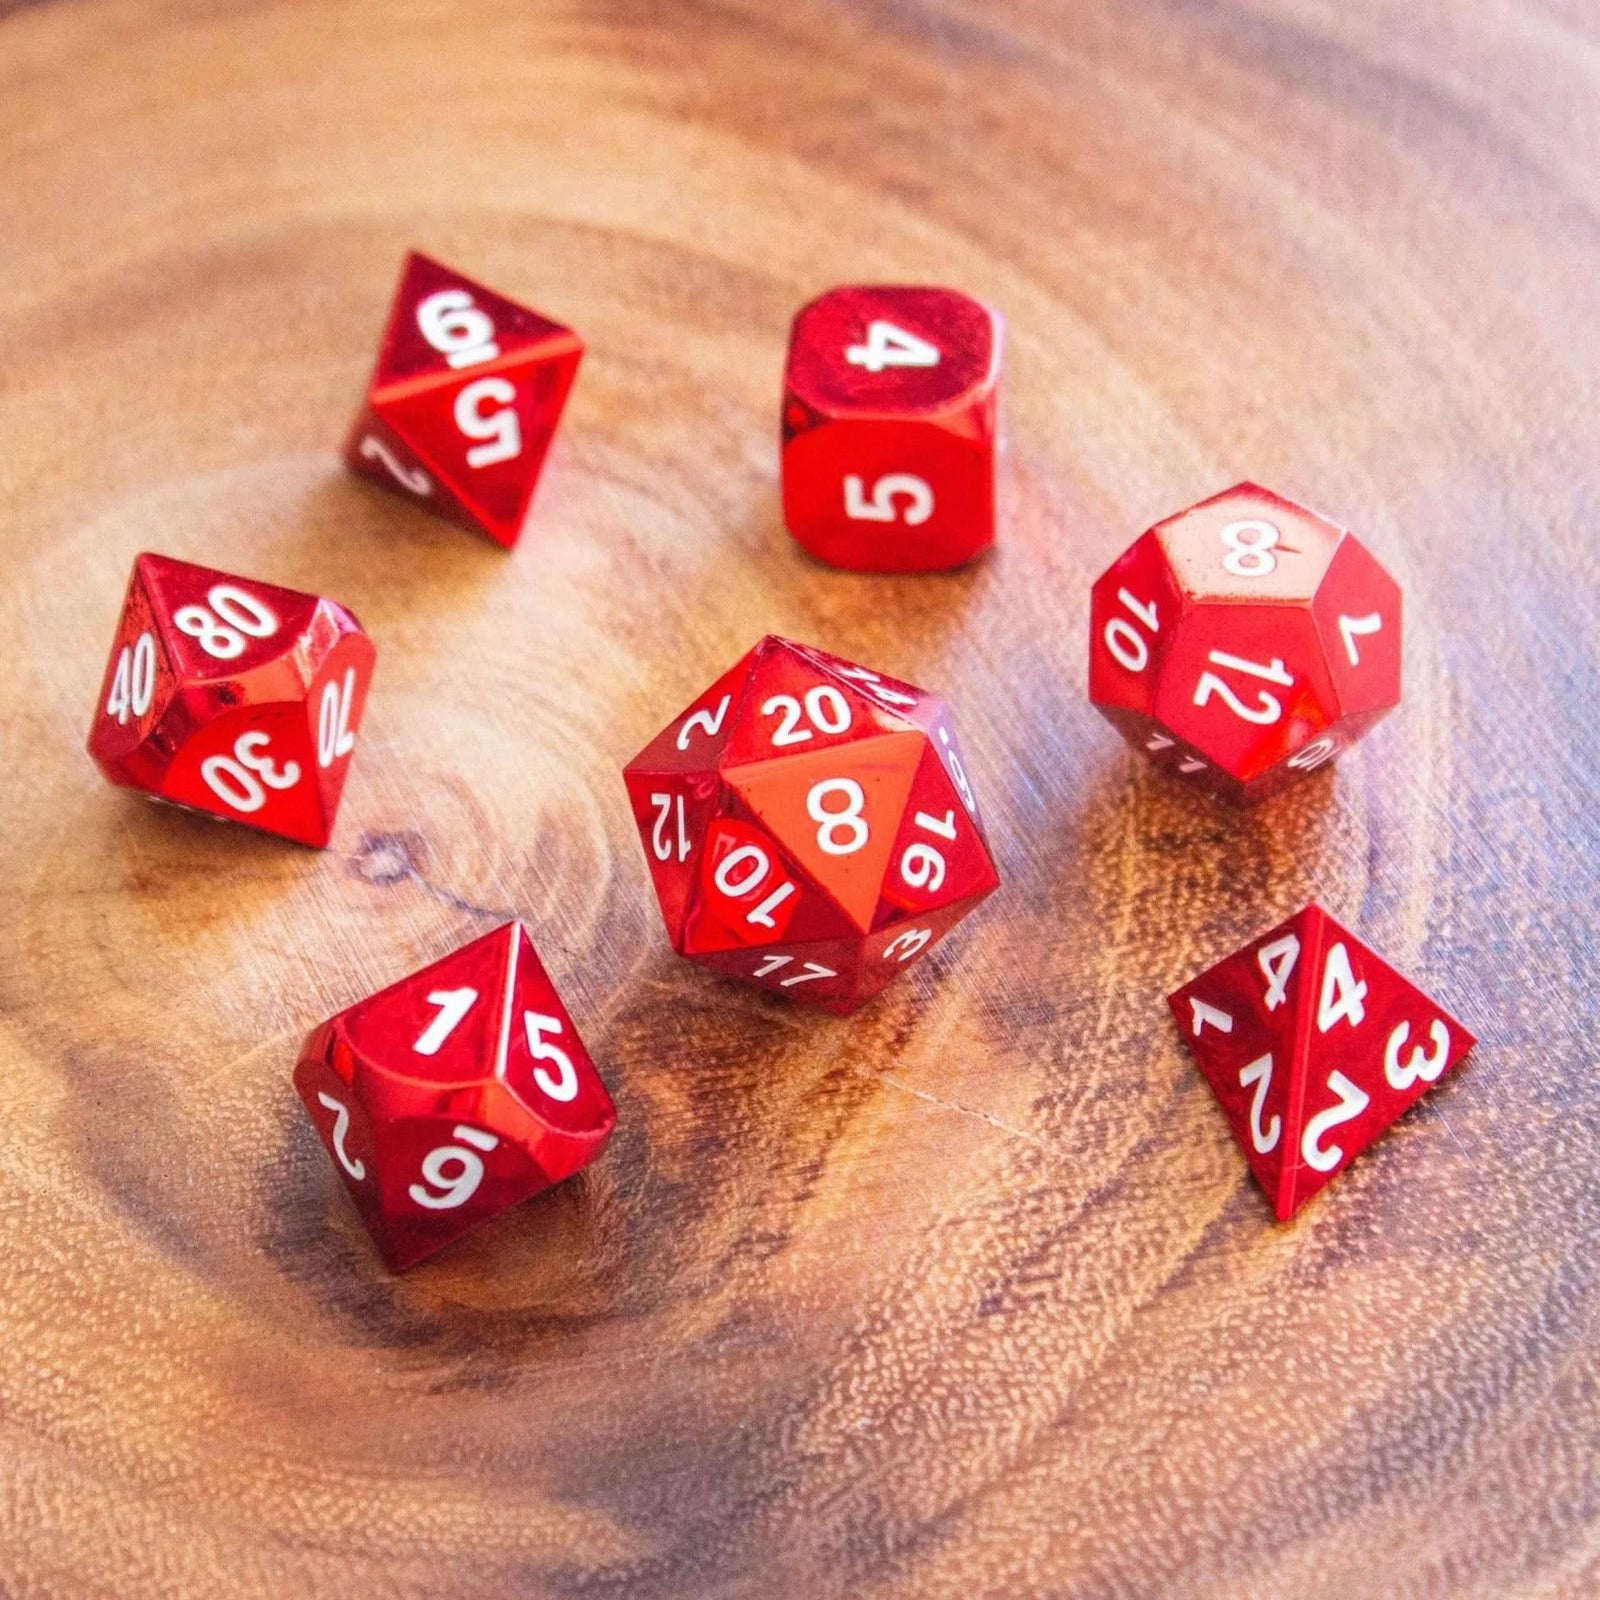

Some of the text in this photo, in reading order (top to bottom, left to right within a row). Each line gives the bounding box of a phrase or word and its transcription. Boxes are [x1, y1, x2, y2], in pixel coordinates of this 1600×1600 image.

[417, 289, 498, 369] 6
[846, 322, 940, 372] 4
[455, 379, 520, 466] 5
[846, 476, 932, 523] 5
[1220, 519, 1279, 577] 8
[174, 586, 277, 659] 80
[1105, 589, 1158, 671] 10
[1337, 612, 1383, 666] 7
[107, 632, 156, 724] 40
[1193, 651, 1293, 724] 12
[318, 668, 355, 768] 70
[674, 691, 730, 750] 2
[761, 686, 851, 746] 20
[202, 732, 299, 811] 30
[652, 794, 691, 861] 12
[806, 778, 868, 855] 8
[901, 811, 956, 891] 16
[715, 846, 794, 927] 10
[753, 956, 836, 986] 17
[883, 929, 936, 962] 3
[1258, 935, 1299, 1010] 4
[414, 988, 477, 1055] 1
[1190, 998, 1232, 1036] 1
[1318, 942, 1368, 1032] 4
[525, 1010, 579, 1101] 5
[1385, 1019, 1449, 1089] 3
[318, 1092, 365, 1180] 2
[1240, 1054, 1280, 1153] 2
[1302, 1070, 1370, 1171] 2
